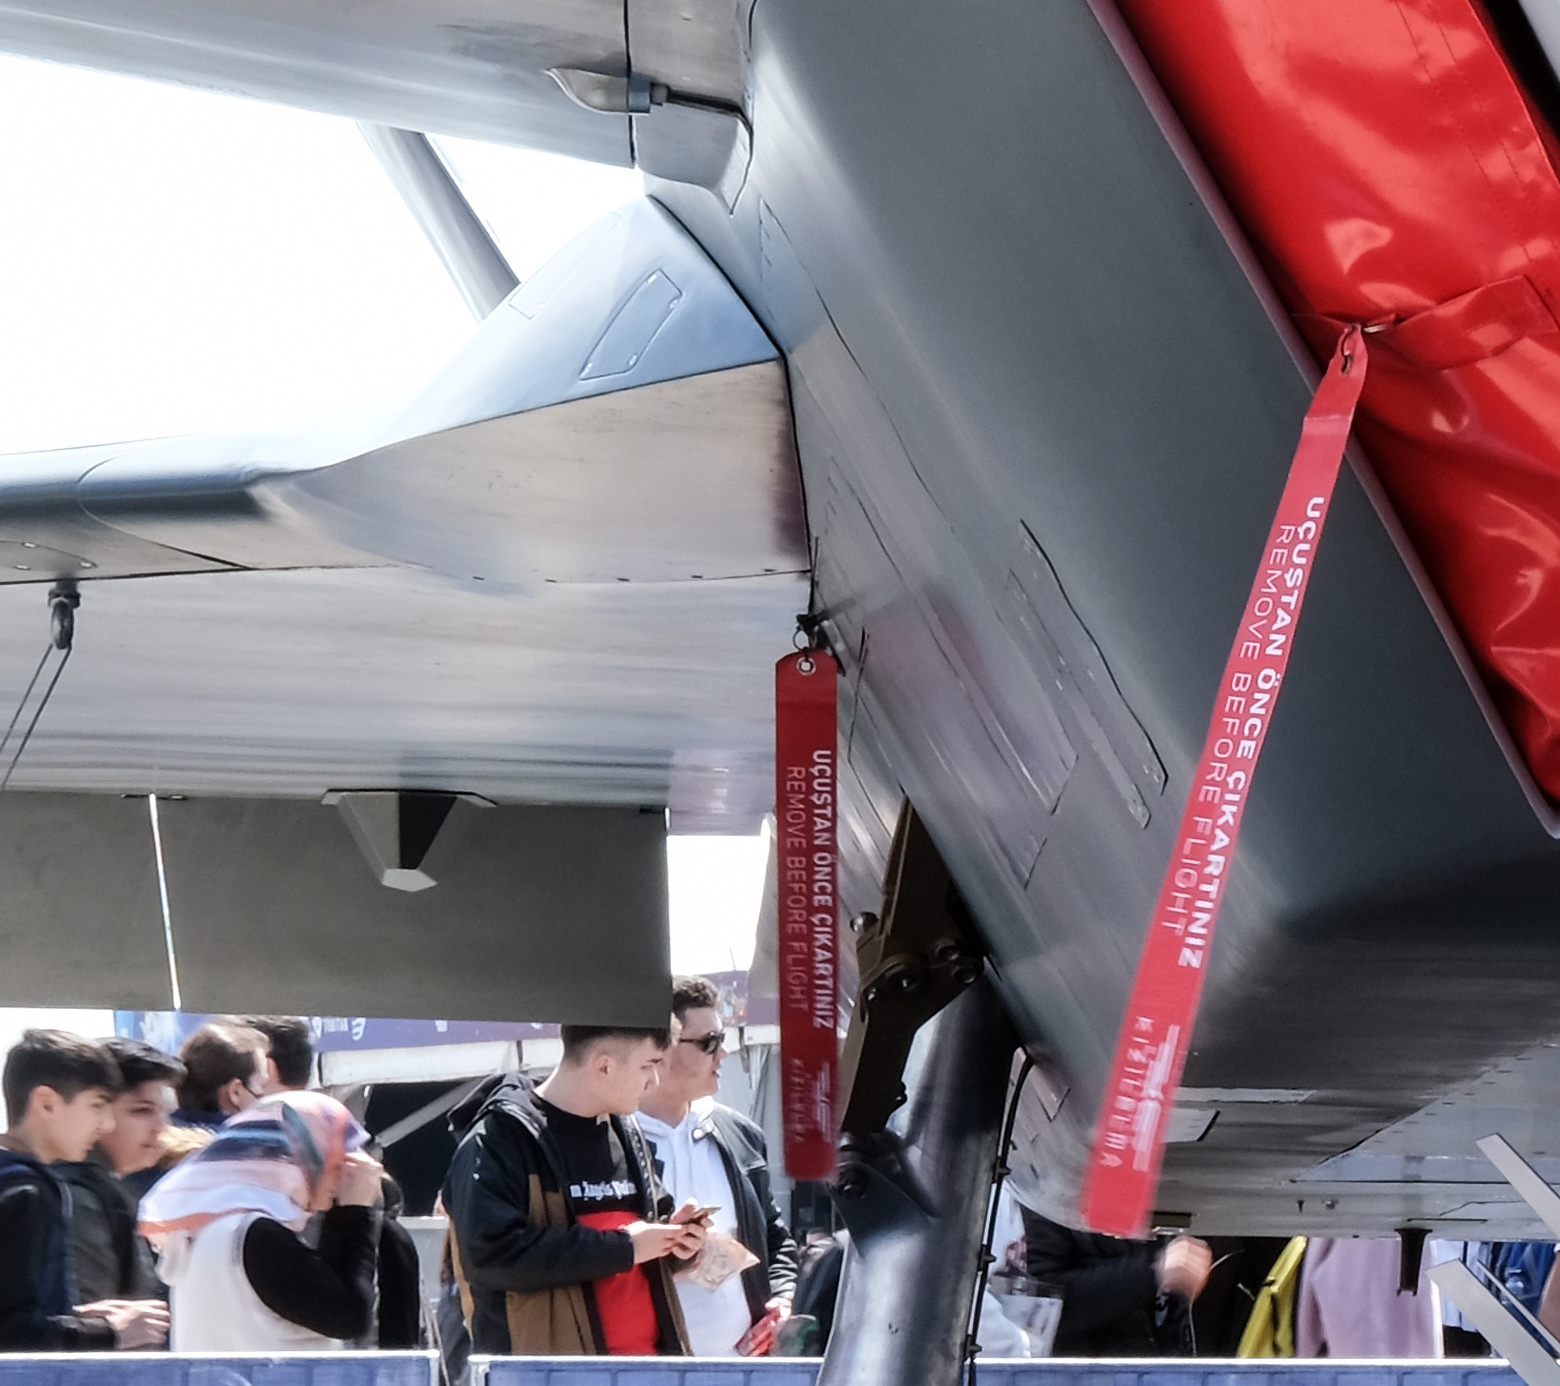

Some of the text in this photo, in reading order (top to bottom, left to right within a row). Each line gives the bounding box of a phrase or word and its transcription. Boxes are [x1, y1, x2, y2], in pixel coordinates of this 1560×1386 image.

[786, 765, 809, 1013] REMOVE BEFORE FLIGHT
[812, 749, 834, 1030] UÇUŞTAN ÖNCE ÇIKARTINIZ
[1165, 524, 1296, 937] REMOVE BEFORE FLIGHT
[1177, 496, 1325, 969] UÇUŞTAN ÖNCE ÇIKARTINIZ
